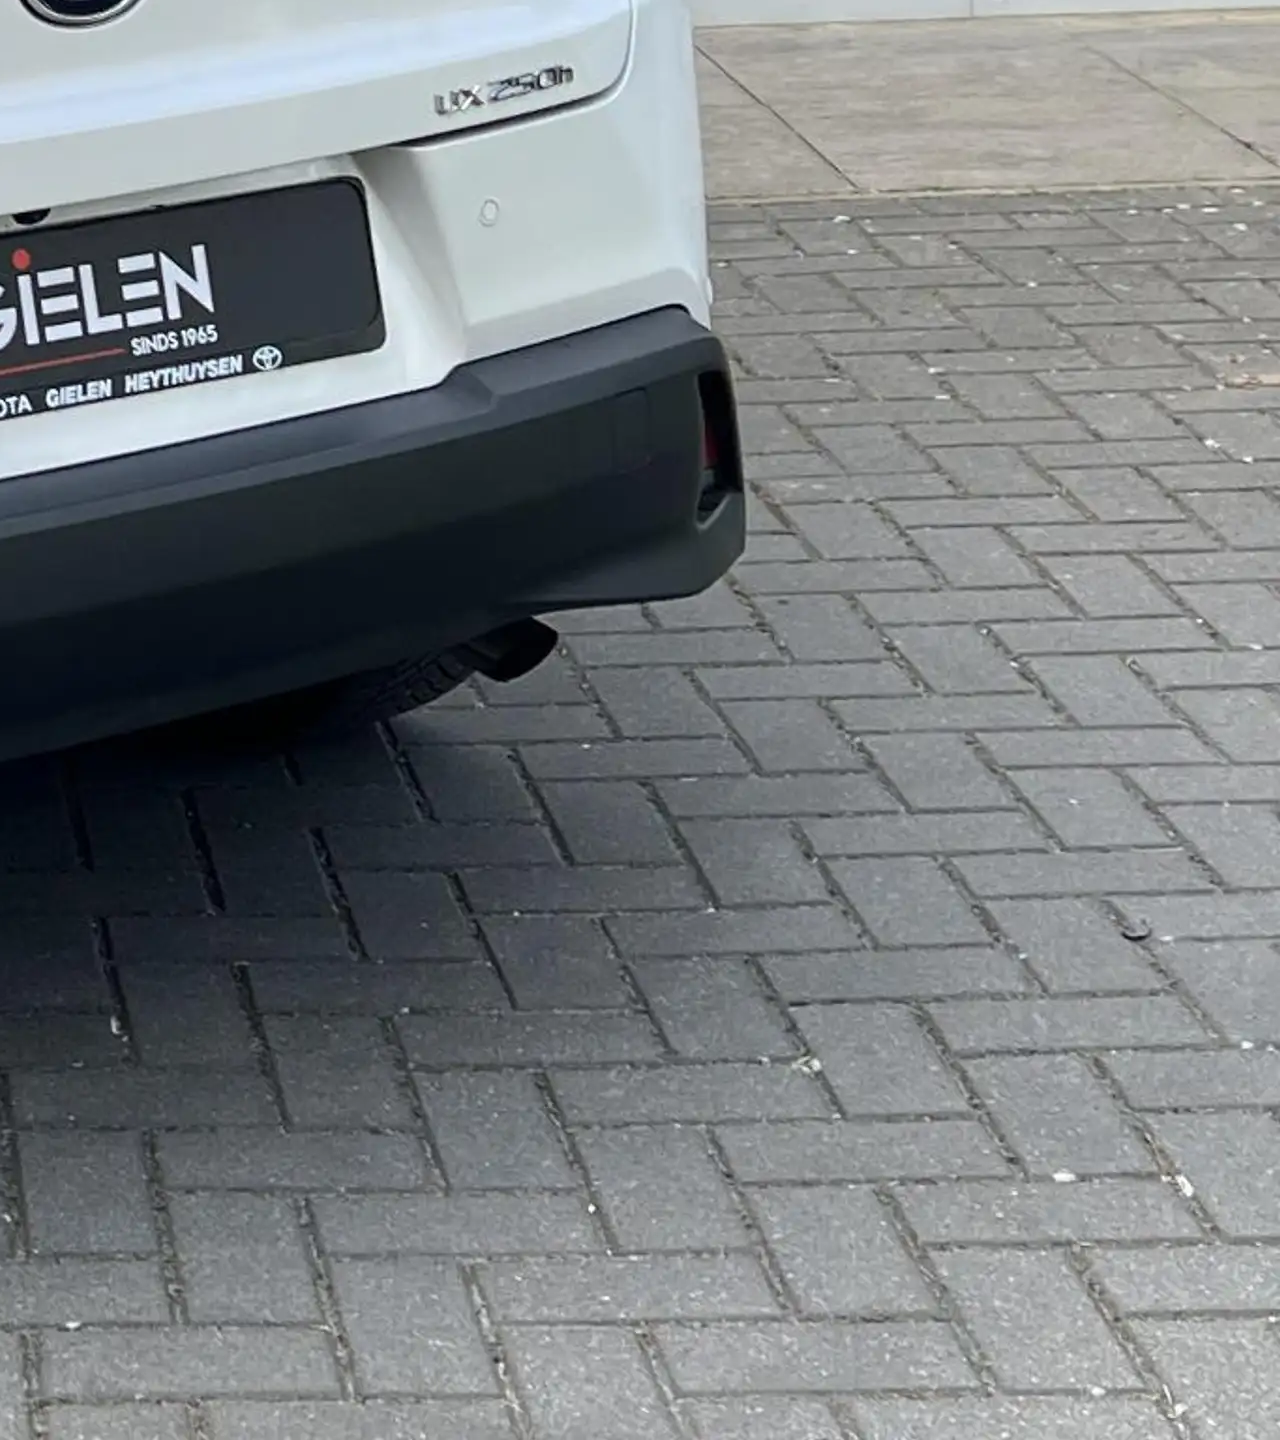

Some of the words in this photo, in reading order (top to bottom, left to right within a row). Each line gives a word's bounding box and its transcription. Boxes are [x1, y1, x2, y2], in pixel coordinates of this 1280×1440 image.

[434, 83, 486, 116] UX
[487, 65, 574, 102] 250h
[131, 332, 179, 357] SINDS
[181, 324, 219, 349] 1965
[46, 377, 112, 408] GIELEN
[124, 355, 244, 393] HEYTHUYSEN
